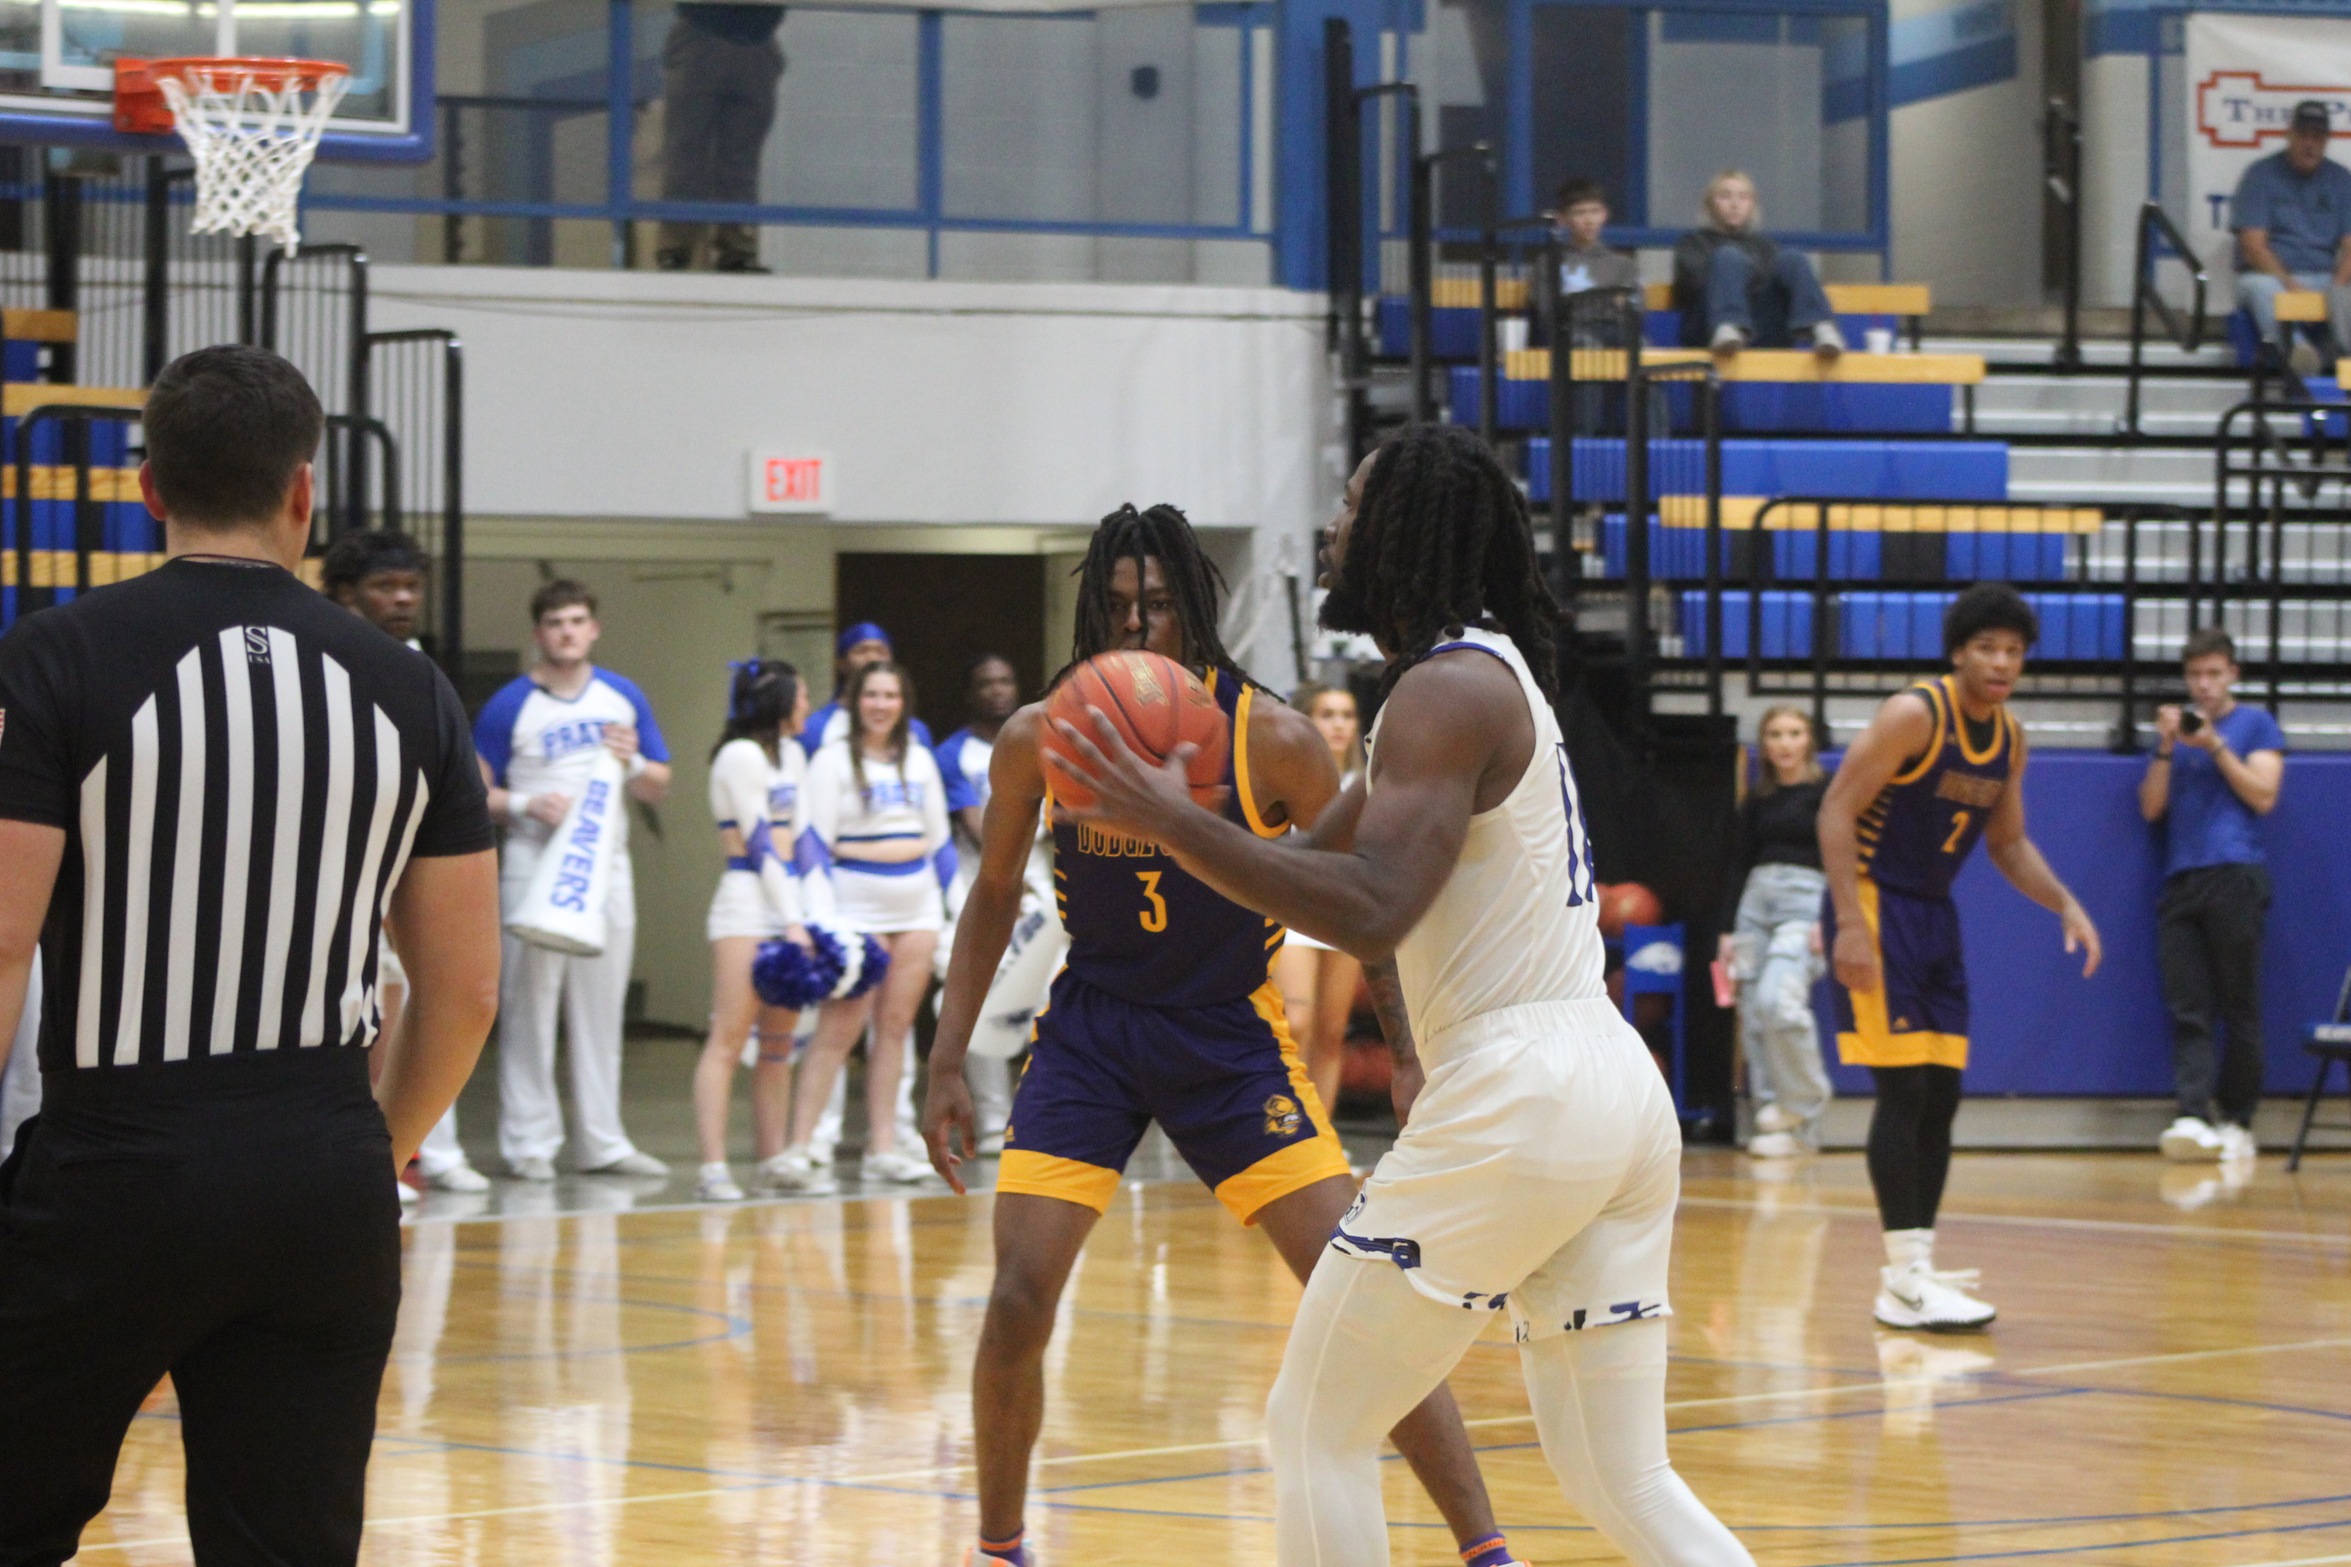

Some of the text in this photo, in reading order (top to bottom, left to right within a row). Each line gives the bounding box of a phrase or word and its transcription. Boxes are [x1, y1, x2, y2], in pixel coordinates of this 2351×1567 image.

[765, 459, 822, 502] EXIT
[543, 722, 607, 758] PRAT
[550, 779, 610, 912] BEAVERS
[1135, 871, 1168, 932] 3
